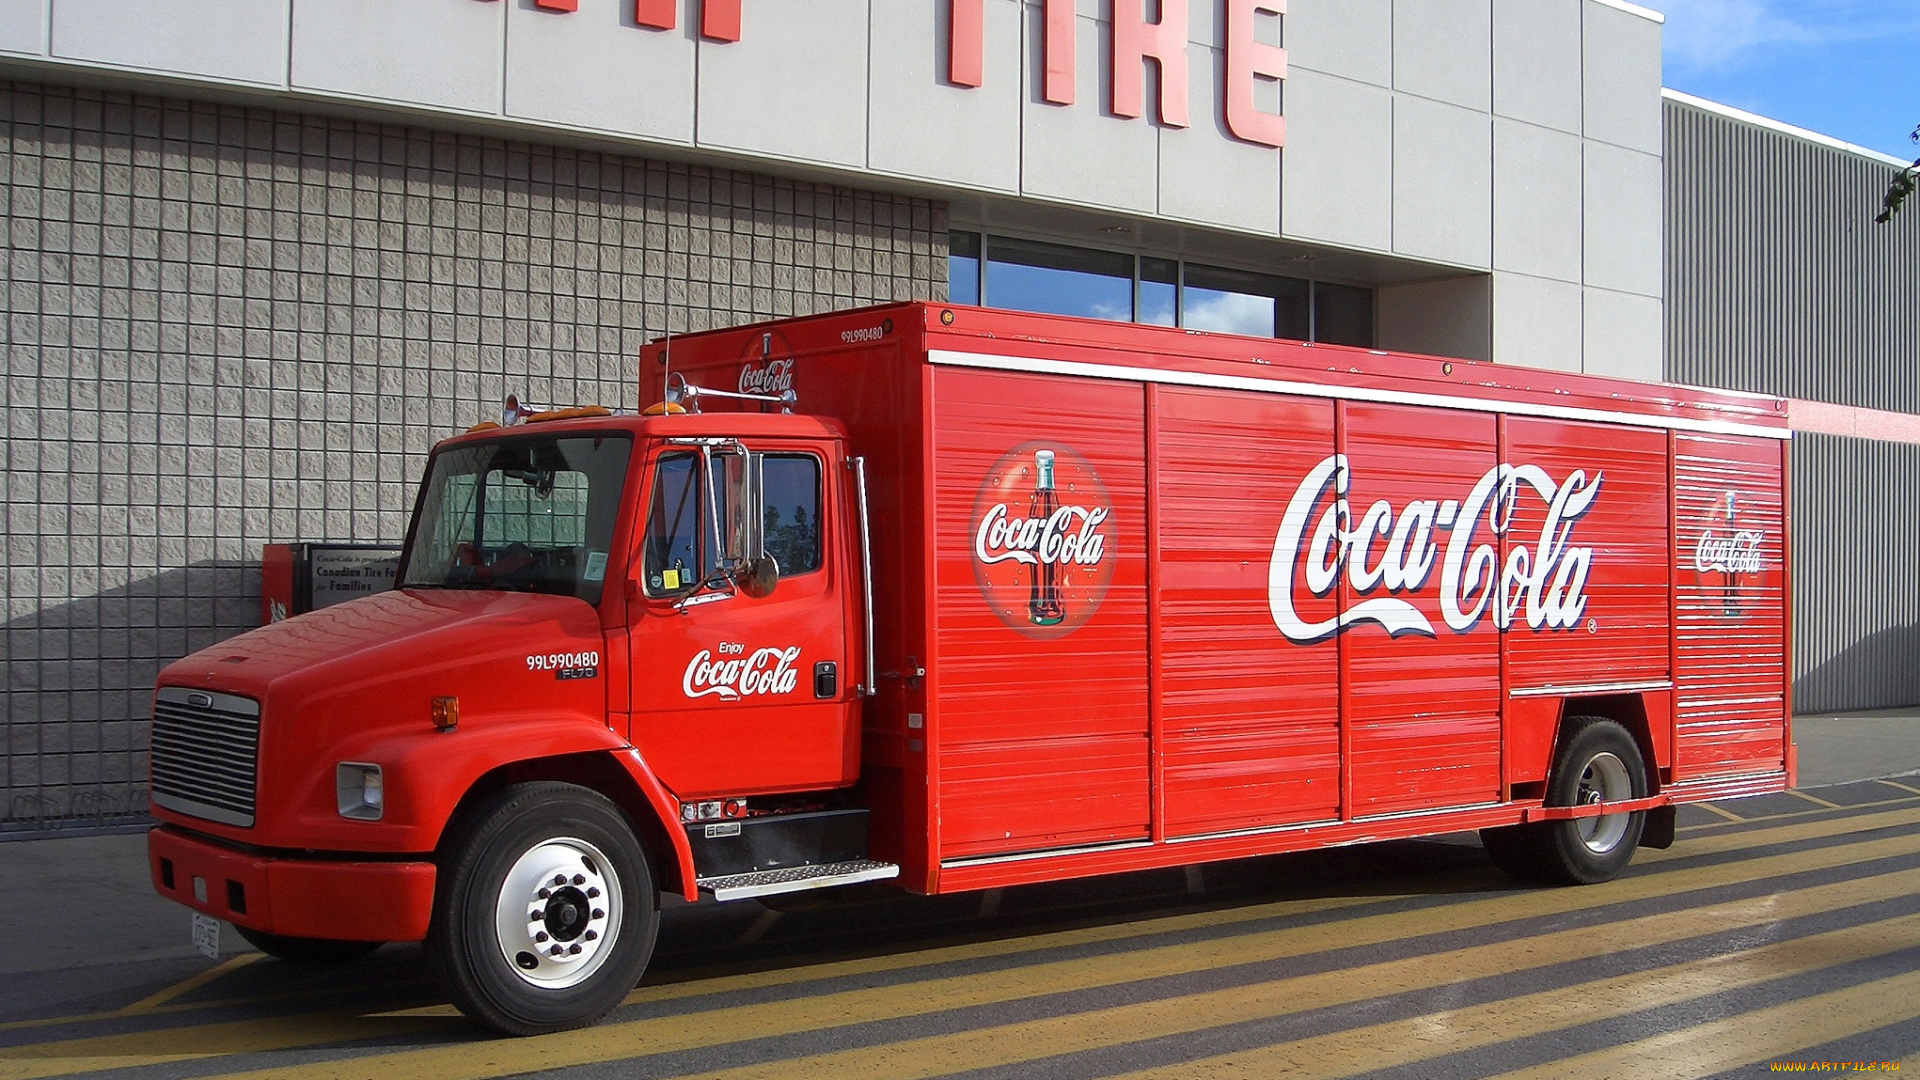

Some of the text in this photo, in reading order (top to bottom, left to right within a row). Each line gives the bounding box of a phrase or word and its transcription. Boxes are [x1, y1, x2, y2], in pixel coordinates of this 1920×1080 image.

[841, 326, 883, 343] 99L990480
[738, 358, 794, 393] Coca-Cola
[975, 503, 1109, 565] Coca-Cola
[1268, 453, 1603, 643] Coca-Cola
[1695, 530, 1765, 573] Coca-Cola
[316, 565, 361, 577] Canadian
[364, 566, 382, 578] Tire
[330, 579, 373, 592] Families
[718, 641, 745, 655] Enjoy
[526, 651, 599, 670] 99L990480
[562, 667, 595, 679] FL70
[682, 646, 801, 698] Coca-Cola
